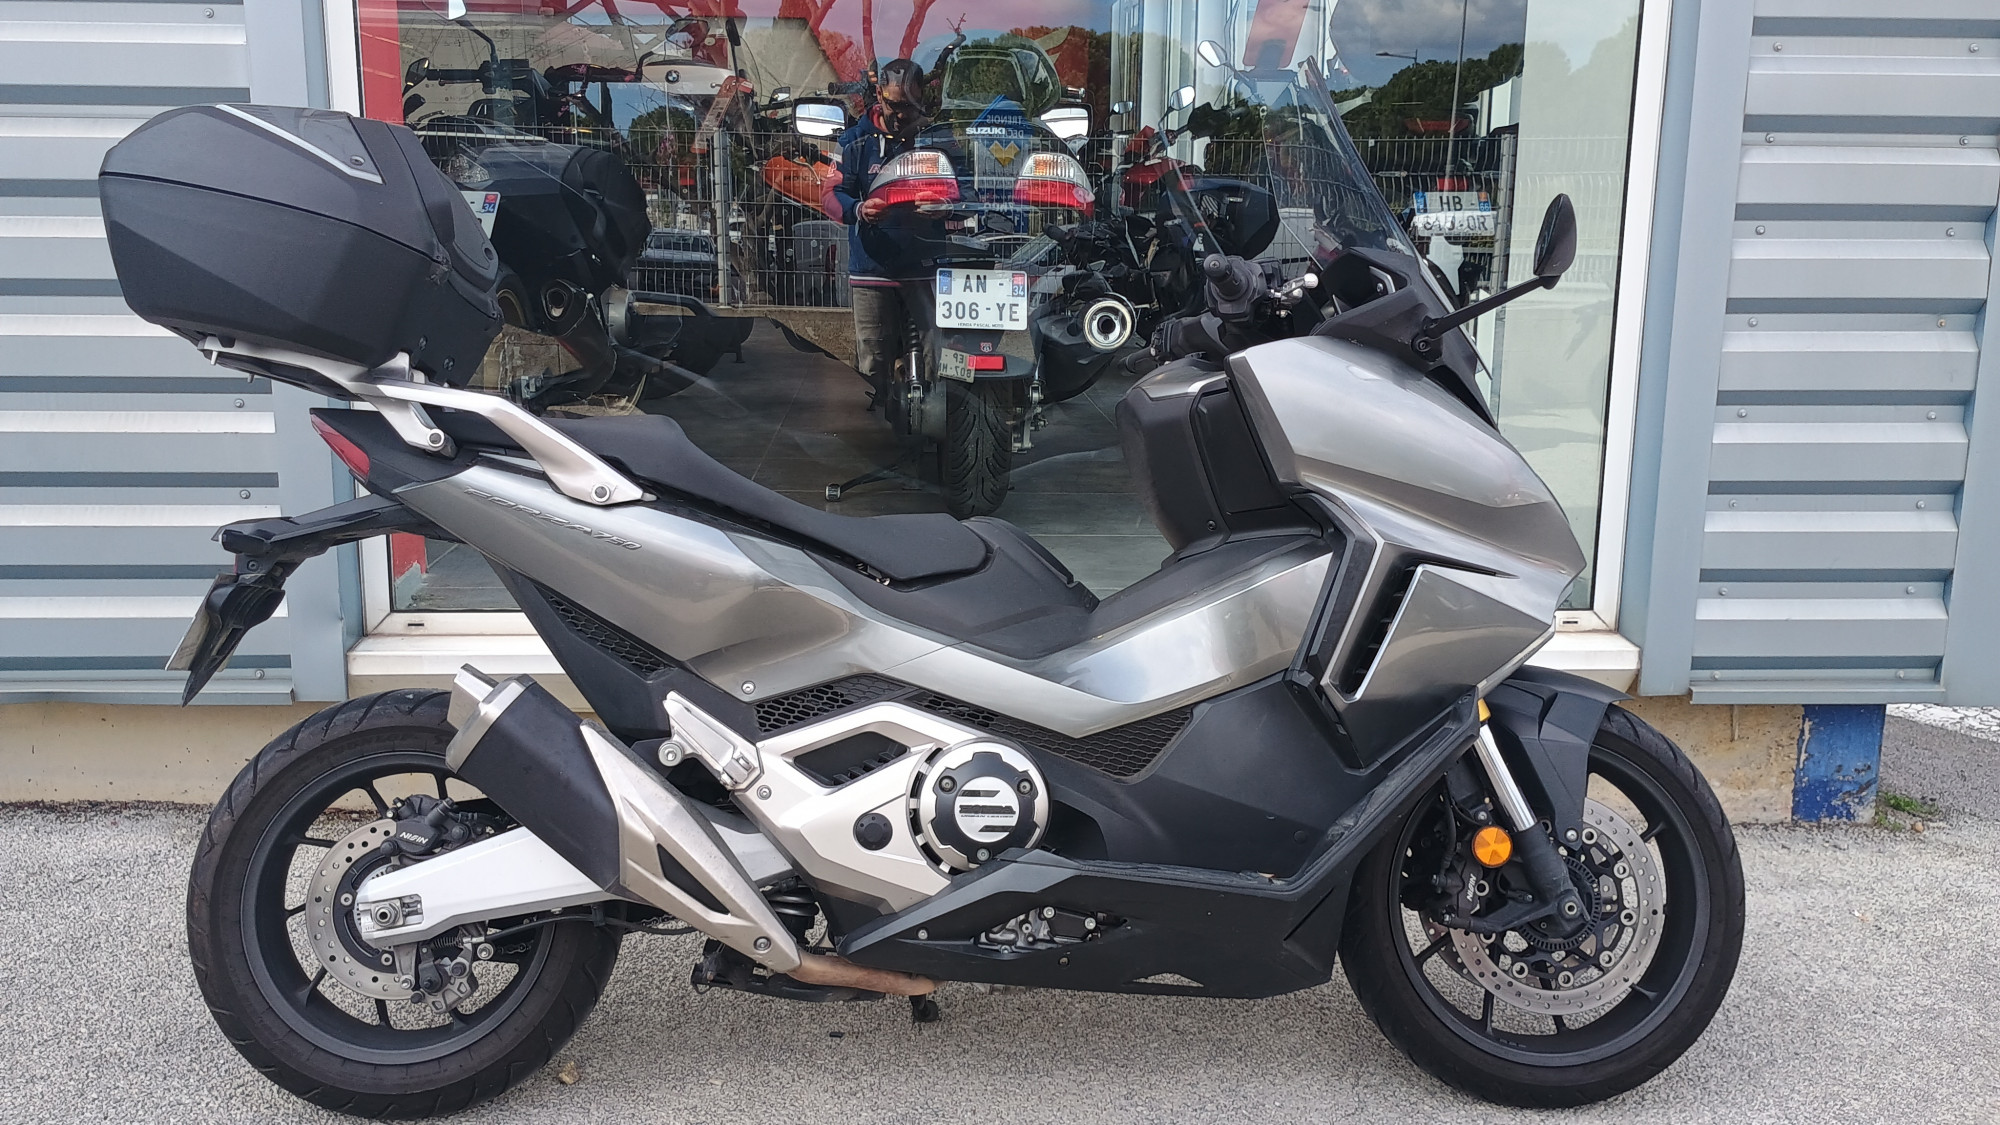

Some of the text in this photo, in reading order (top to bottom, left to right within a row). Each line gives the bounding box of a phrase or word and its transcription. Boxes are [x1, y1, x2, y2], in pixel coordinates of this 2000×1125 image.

[965, 127, 1006, 135] SUZUKI
[484, 203, 496, 212] 34
[1439, 195, 1463, 211] HB
[1480, 203, 1489, 211] 66
[963, 274, 987, 293] AN
[1012, 285, 1024, 296] 34
[463, 485, 643, 551] FORZA 750
